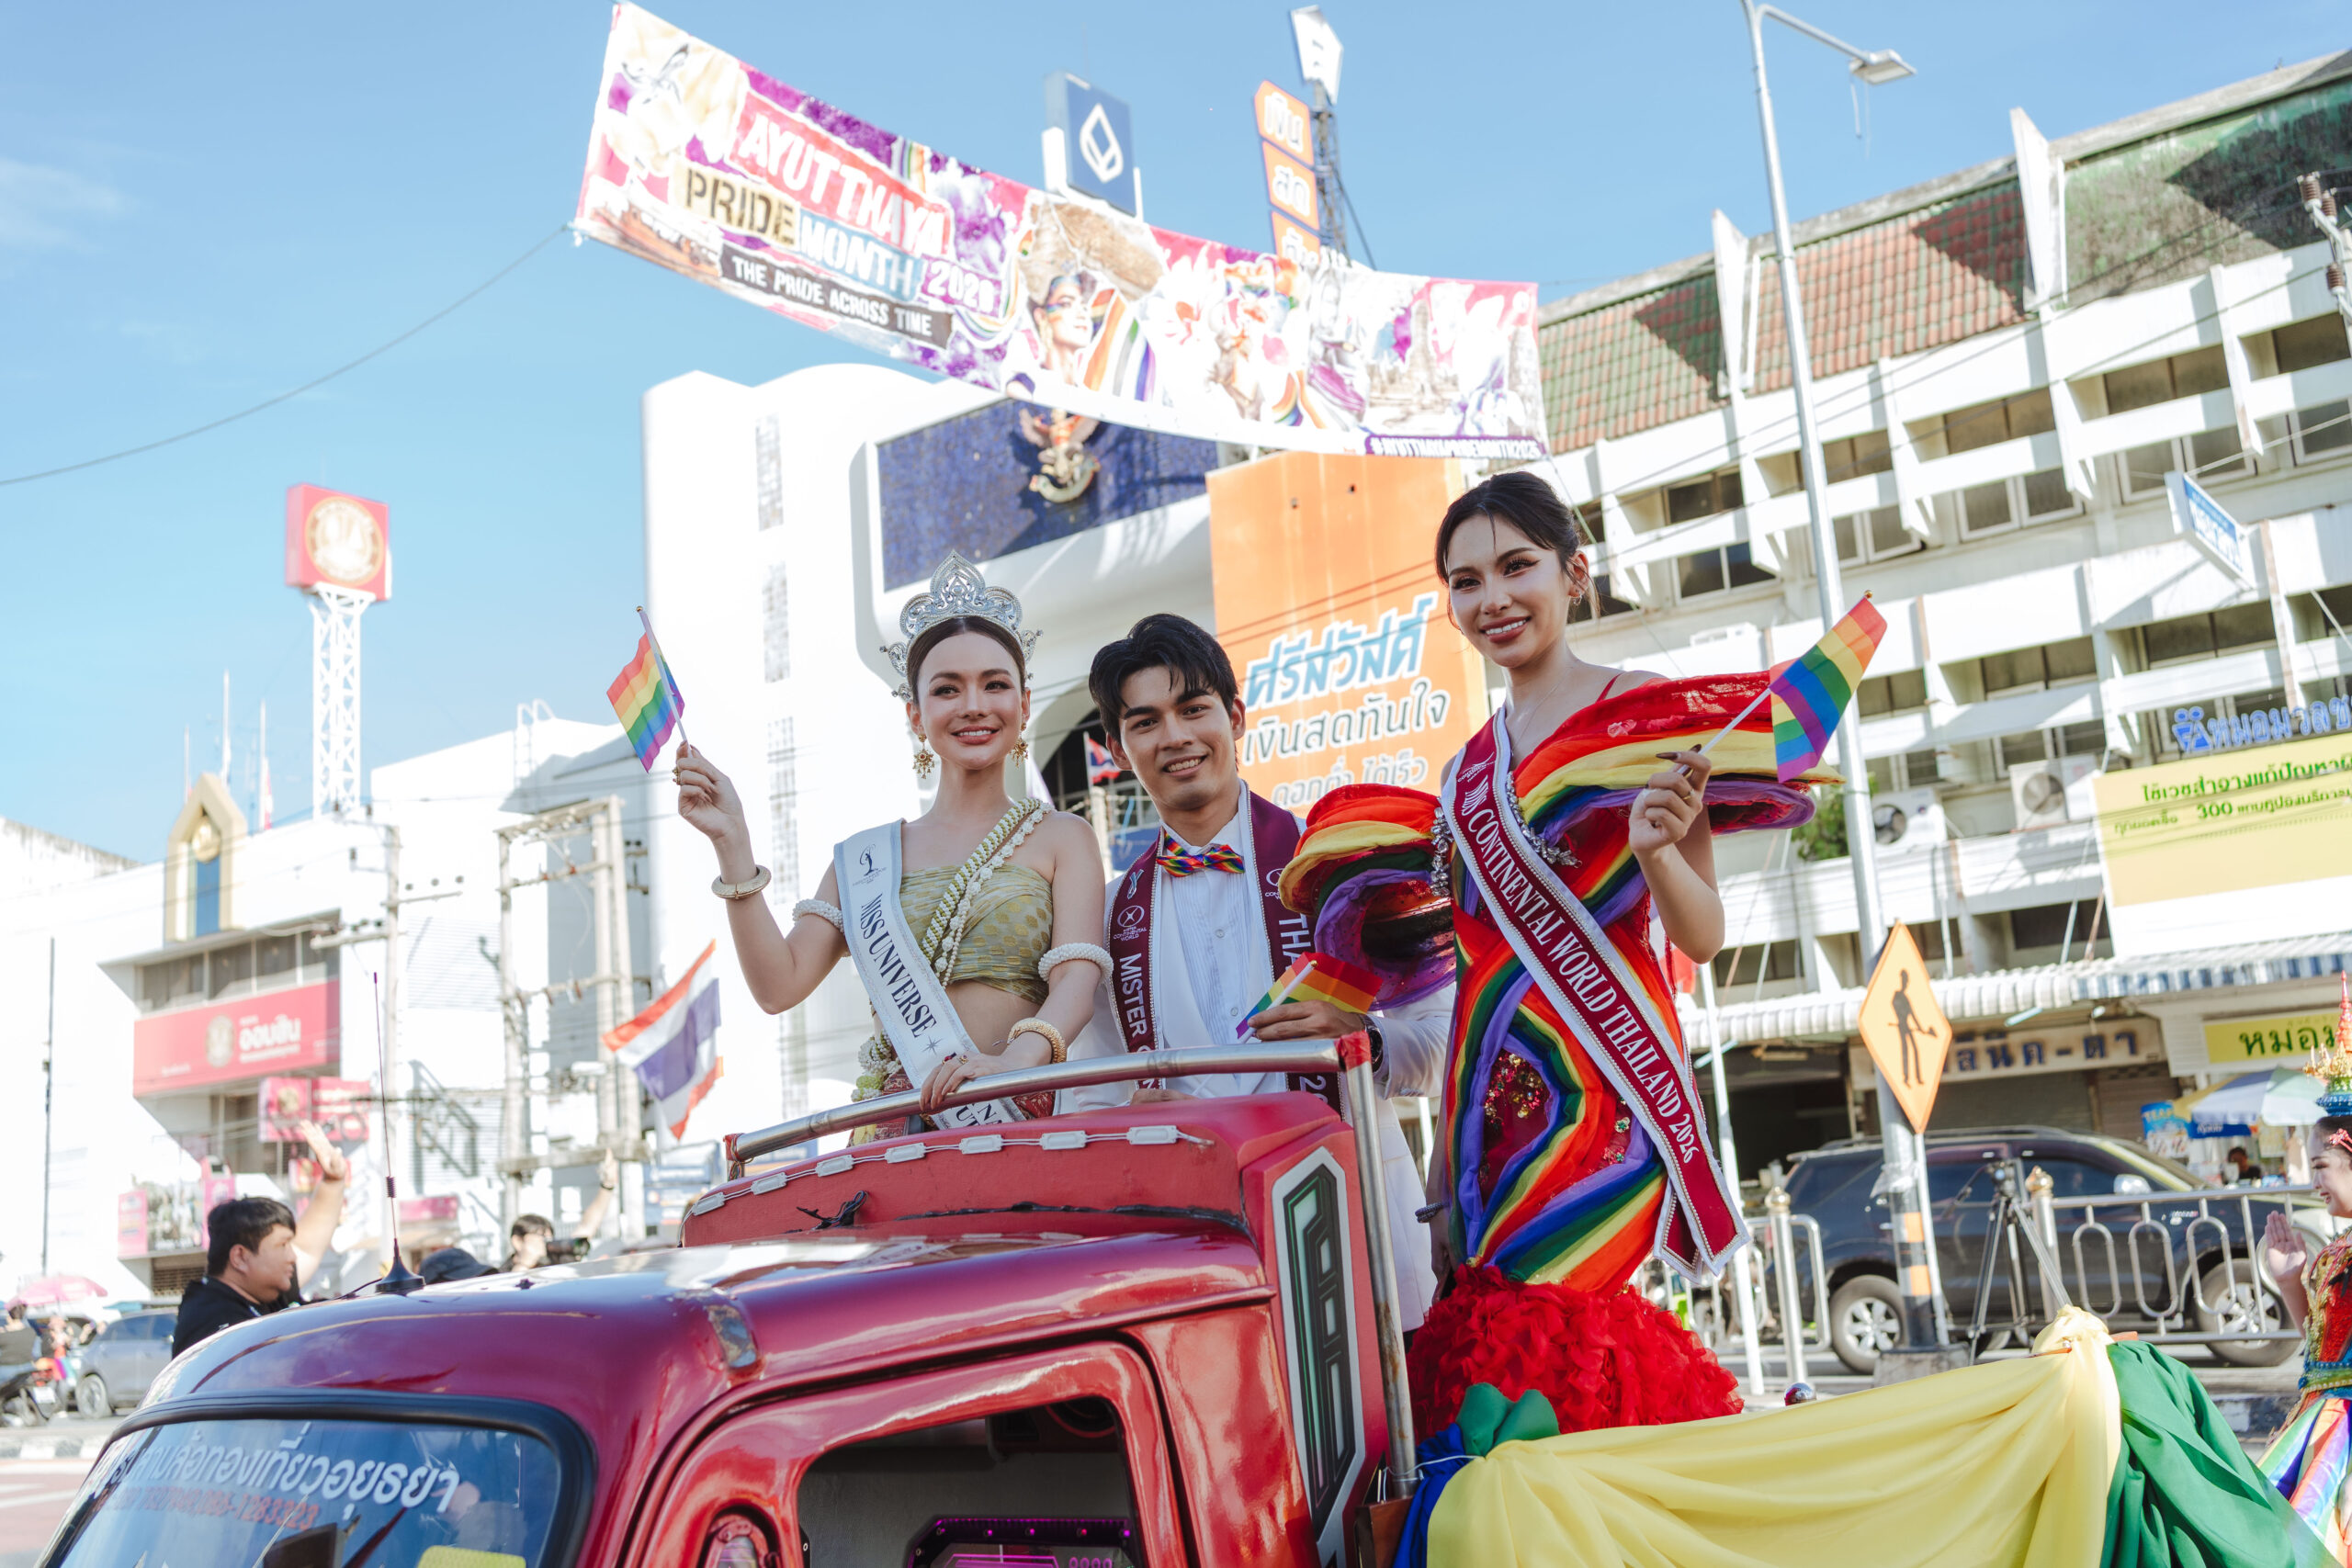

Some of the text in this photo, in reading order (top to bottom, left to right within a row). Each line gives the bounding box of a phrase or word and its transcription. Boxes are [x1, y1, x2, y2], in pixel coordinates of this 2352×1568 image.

[737, 112, 947, 255] AYUTTHAYA
[685, 166, 798, 247] PRIDE
[798, 210, 913, 298] MONTH
[732, 254, 933, 337] THE PRIDE ACROSS TIME
[1245, 682, 1448, 763] เงินสดทันใจ
[2198, 802, 2233, 821] 300
[861, 893, 884, 940] MISS
[868, 928, 937, 1038] UNIVERSE
[1119, 953, 1147, 1038] MISTER
[1467, 808, 1566, 944] CONTINENTAL
[1548, 928, 1617, 1013] WORLD
[1599, 1000, 1684, 1119] THAILAND
[1669, 1111, 1697, 1165] 2026
